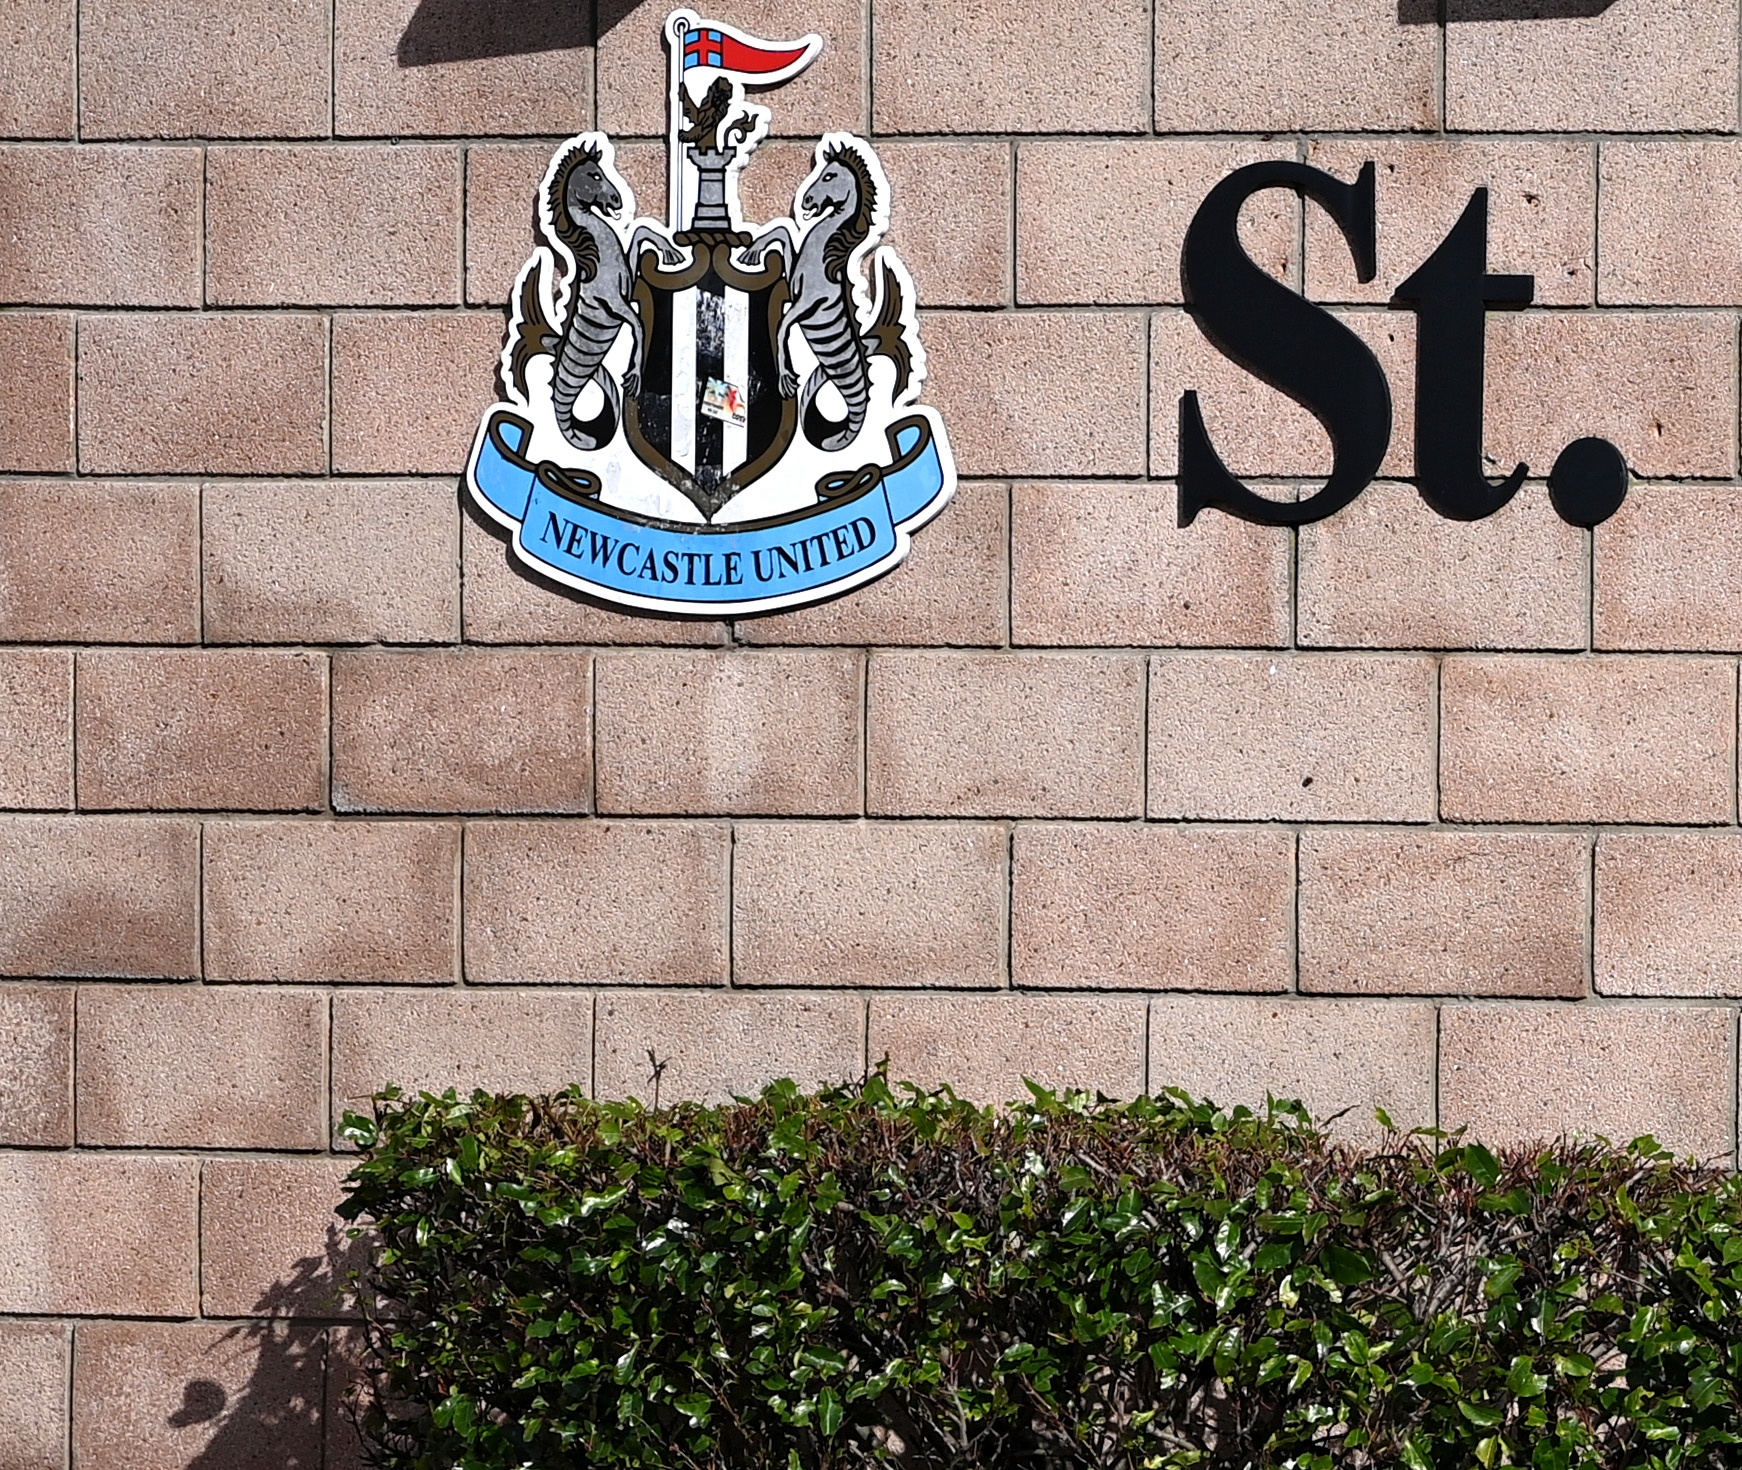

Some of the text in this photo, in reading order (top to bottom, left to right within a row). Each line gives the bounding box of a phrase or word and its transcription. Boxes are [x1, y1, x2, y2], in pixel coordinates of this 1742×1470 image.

[1176, 158, 1630, 529] St.
[539, 510, 877, 587] NEWCASTLE UNITED
